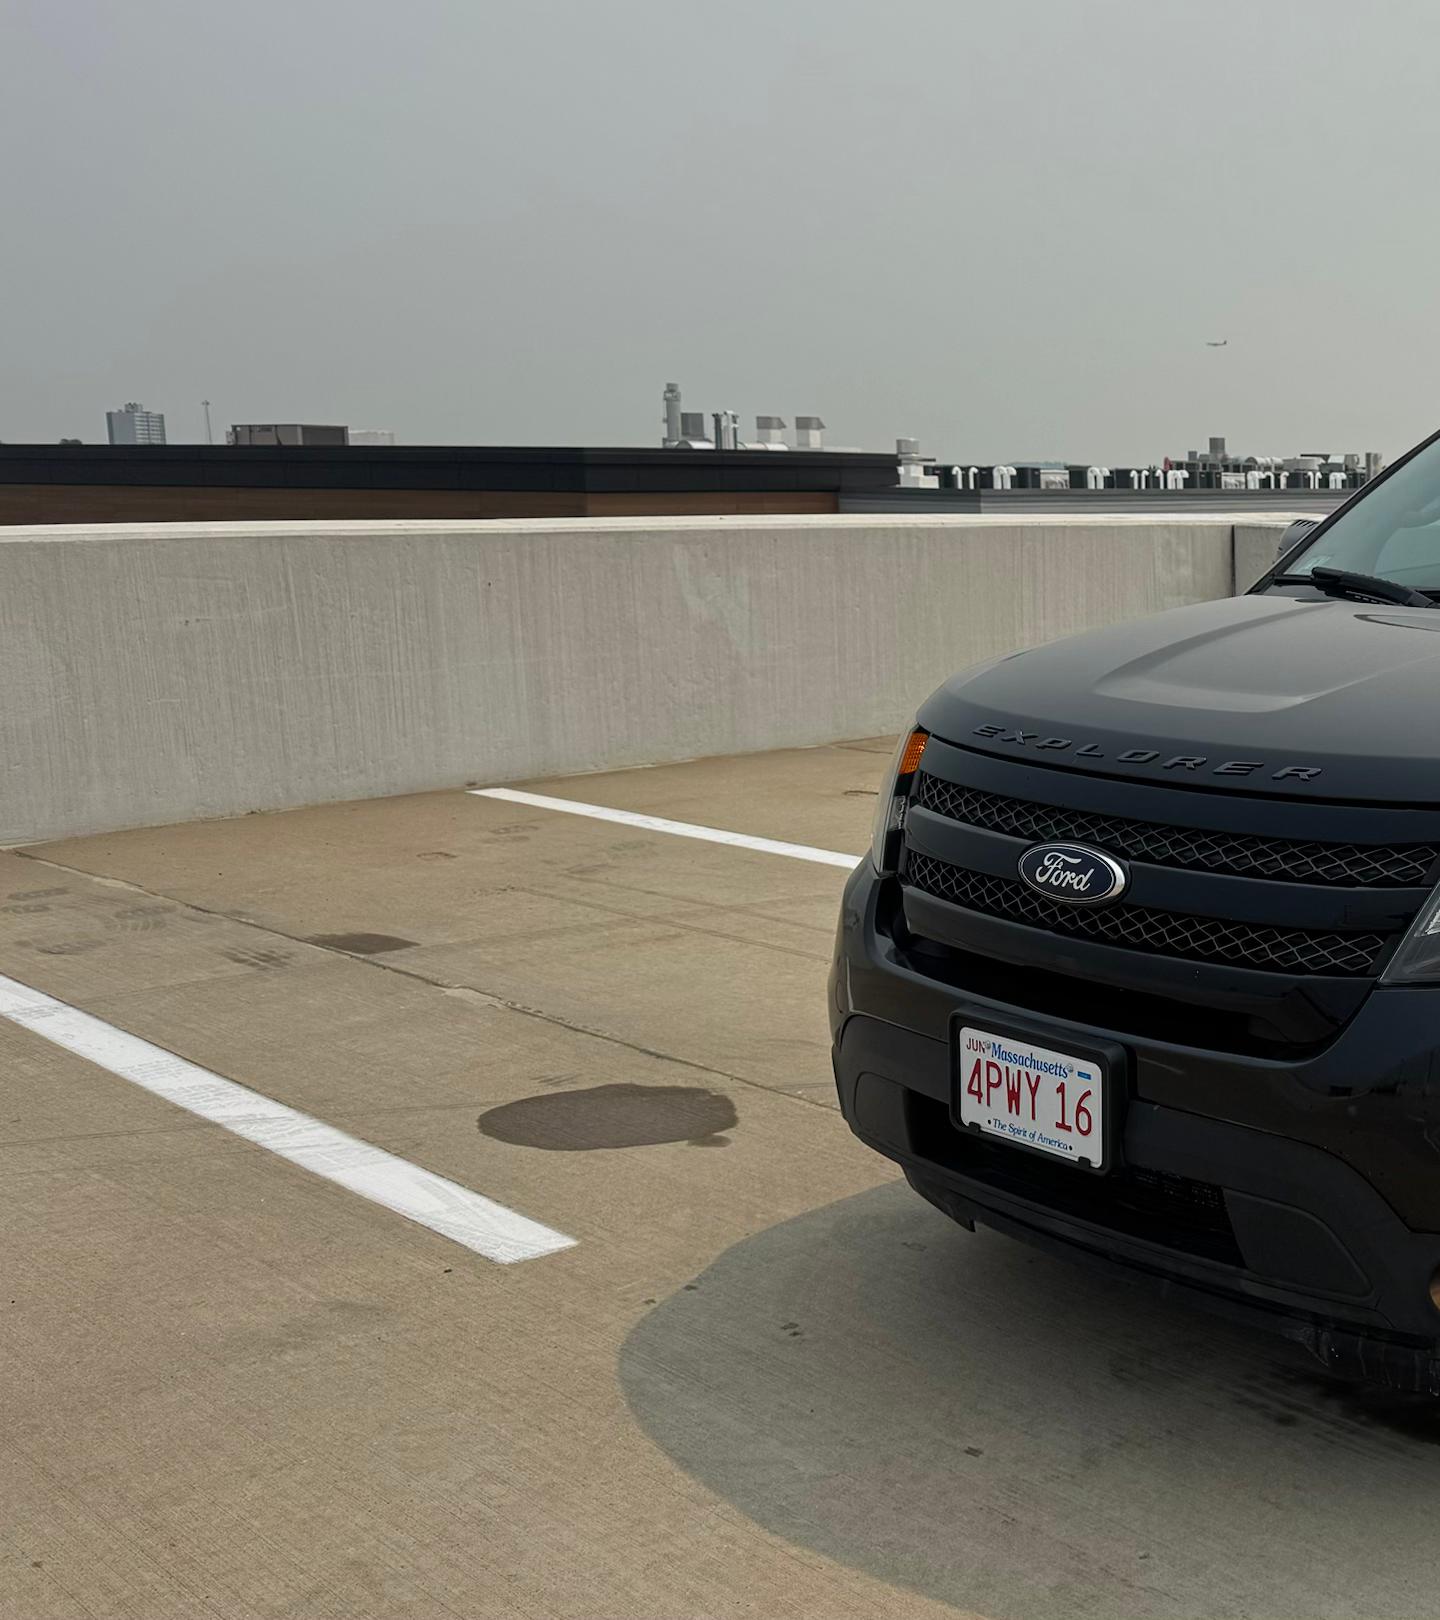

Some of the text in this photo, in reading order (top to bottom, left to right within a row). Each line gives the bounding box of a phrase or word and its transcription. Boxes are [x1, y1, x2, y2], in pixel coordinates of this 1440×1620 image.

[972, 723, 1323, 782] EXPLORER
[1034, 852, 1094, 892] Ford
[966, 1038, 986, 1053] JUN
[991, 1042, 1068, 1078] Massachusetts
[967, 1058, 1092, 1136] 4PWY 16
[993, 1118, 1068, 1149] The Spirit of America
